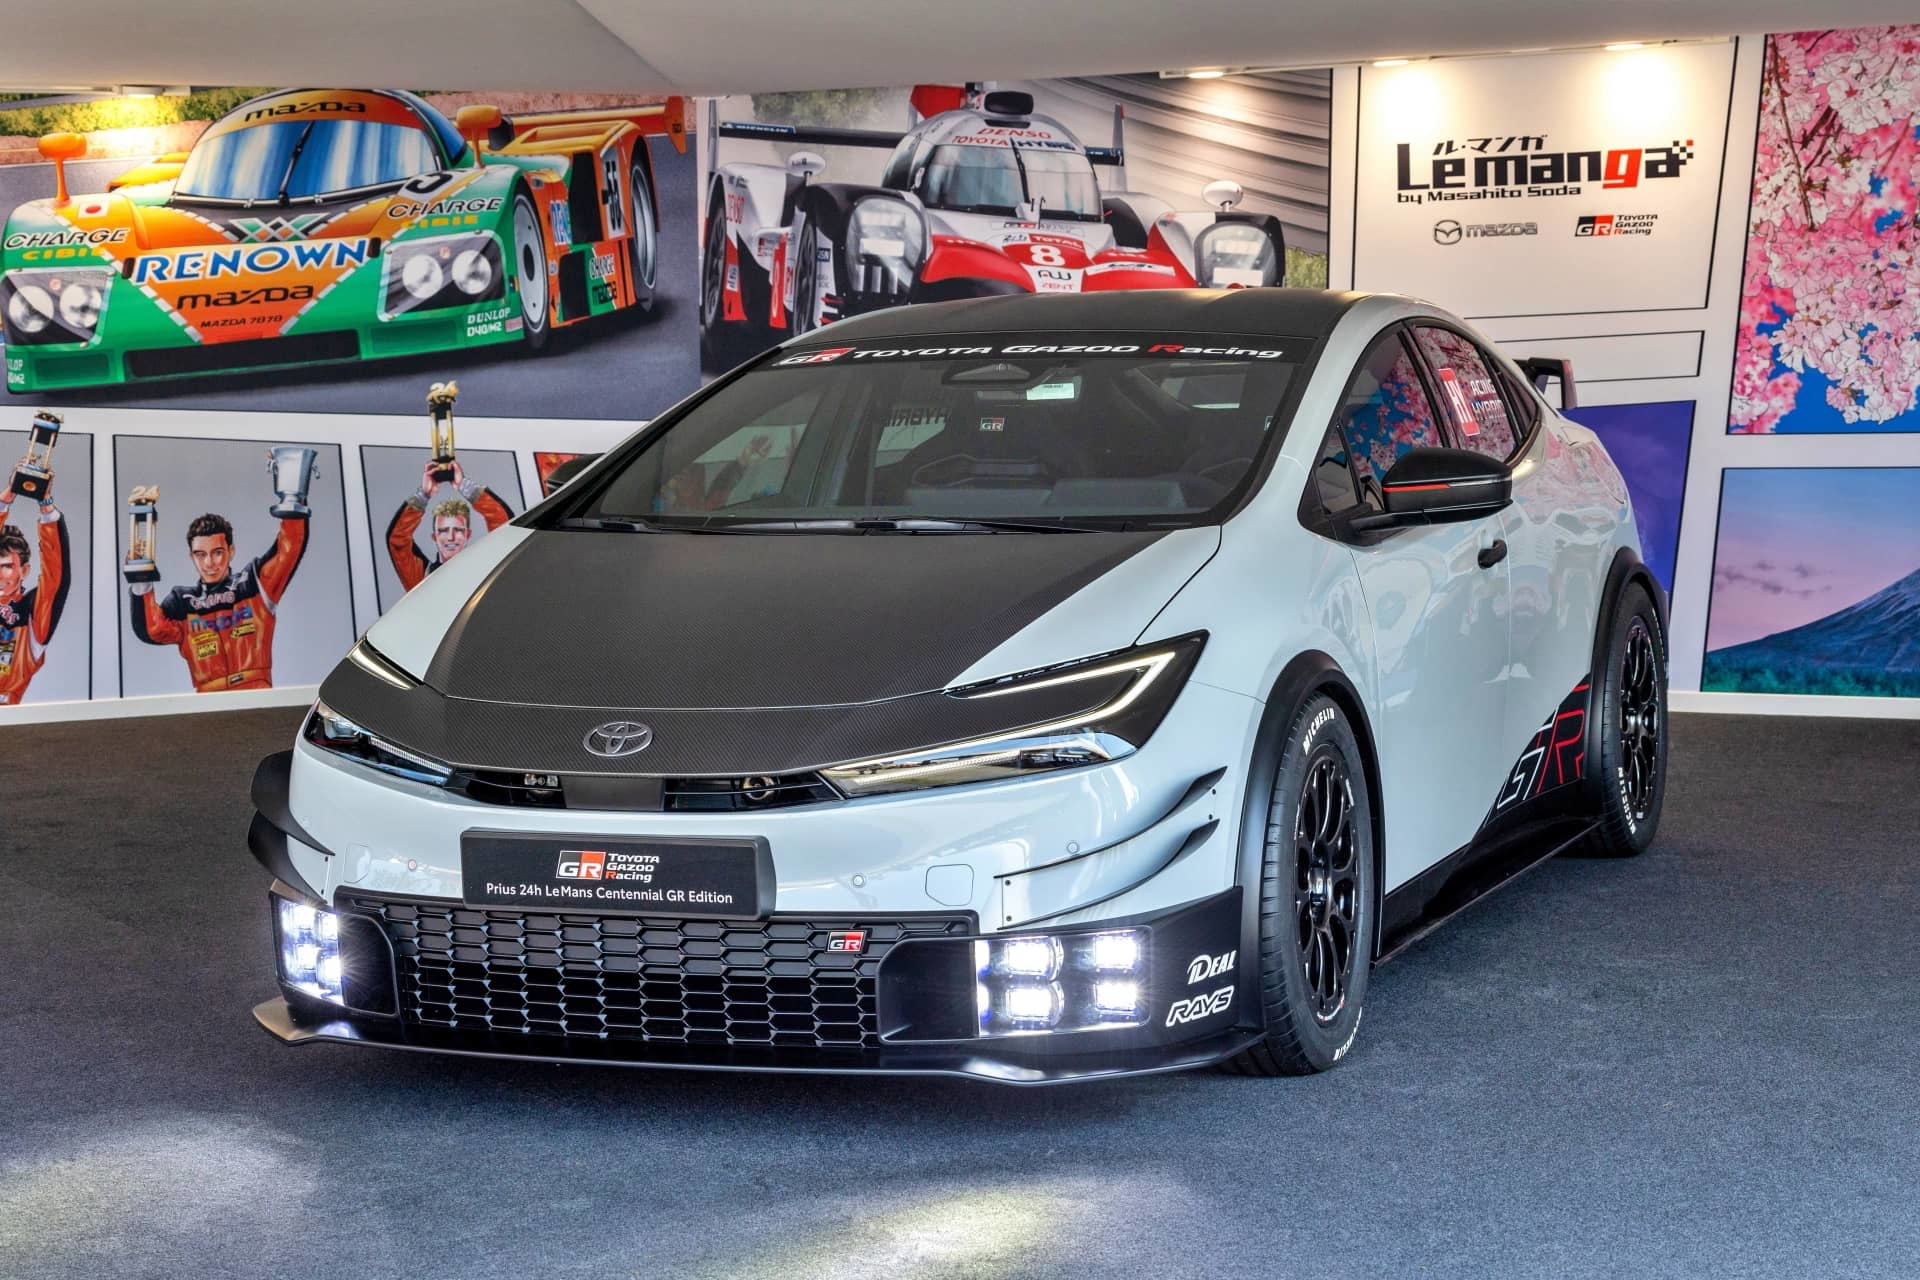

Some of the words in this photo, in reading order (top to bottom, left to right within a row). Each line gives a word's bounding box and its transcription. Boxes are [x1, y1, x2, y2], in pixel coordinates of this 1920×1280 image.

[244, 101, 366, 121] mazda
[952, 135, 1009, 146] TOYOTA
[977, 128, 1051, 139] DENSO
[1397, 193, 1423, 205] by
[1428, 187, 1522, 202] Masahito
[1528, 184, 1581, 198] Soda
[388, 198, 503, 218] CHARGE
[1466, 221, 1538, 238] mazda
[1576, 221, 1613, 236] GR
[1615, 228, 1652, 236] Racing
[4, 229, 130, 249] CHARGE
[1031, 235, 1083, 248] TOTAL
[135, 238, 368, 285] RENOWN
[1029, 244, 1067, 267] 8
[177, 285, 314, 309] mazda
[200, 319, 247, 329] MAZDA
[467, 307, 511, 325] DUNLOP
[773, 348, 850, 367] GR
[853, 347, 993, 359] TOYOTA
[1001, 344, 1140, 354] GAZOO
[1147, 343, 1283, 360] Racing
[981, 420, 1004, 431] GR
[1303, 707, 1335, 757] MICHELIN
[1618, 767, 1636, 835] MICHELIN
[558, 859, 603, 879] GR
[608, 853, 660, 864] TOYOTA
[606, 862, 655, 873] GAZOO
[606, 871, 652, 883] Racing
[486, 882, 517, 896] Prius
[519, 883, 542, 897] 24h
[596, 887, 663, 902] Centennial
[667, 889, 685, 902] GR
[689, 890, 733, 904] Edition
[829, 936, 862, 950] GR
[1165, 984, 1235, 1028] RAYS
